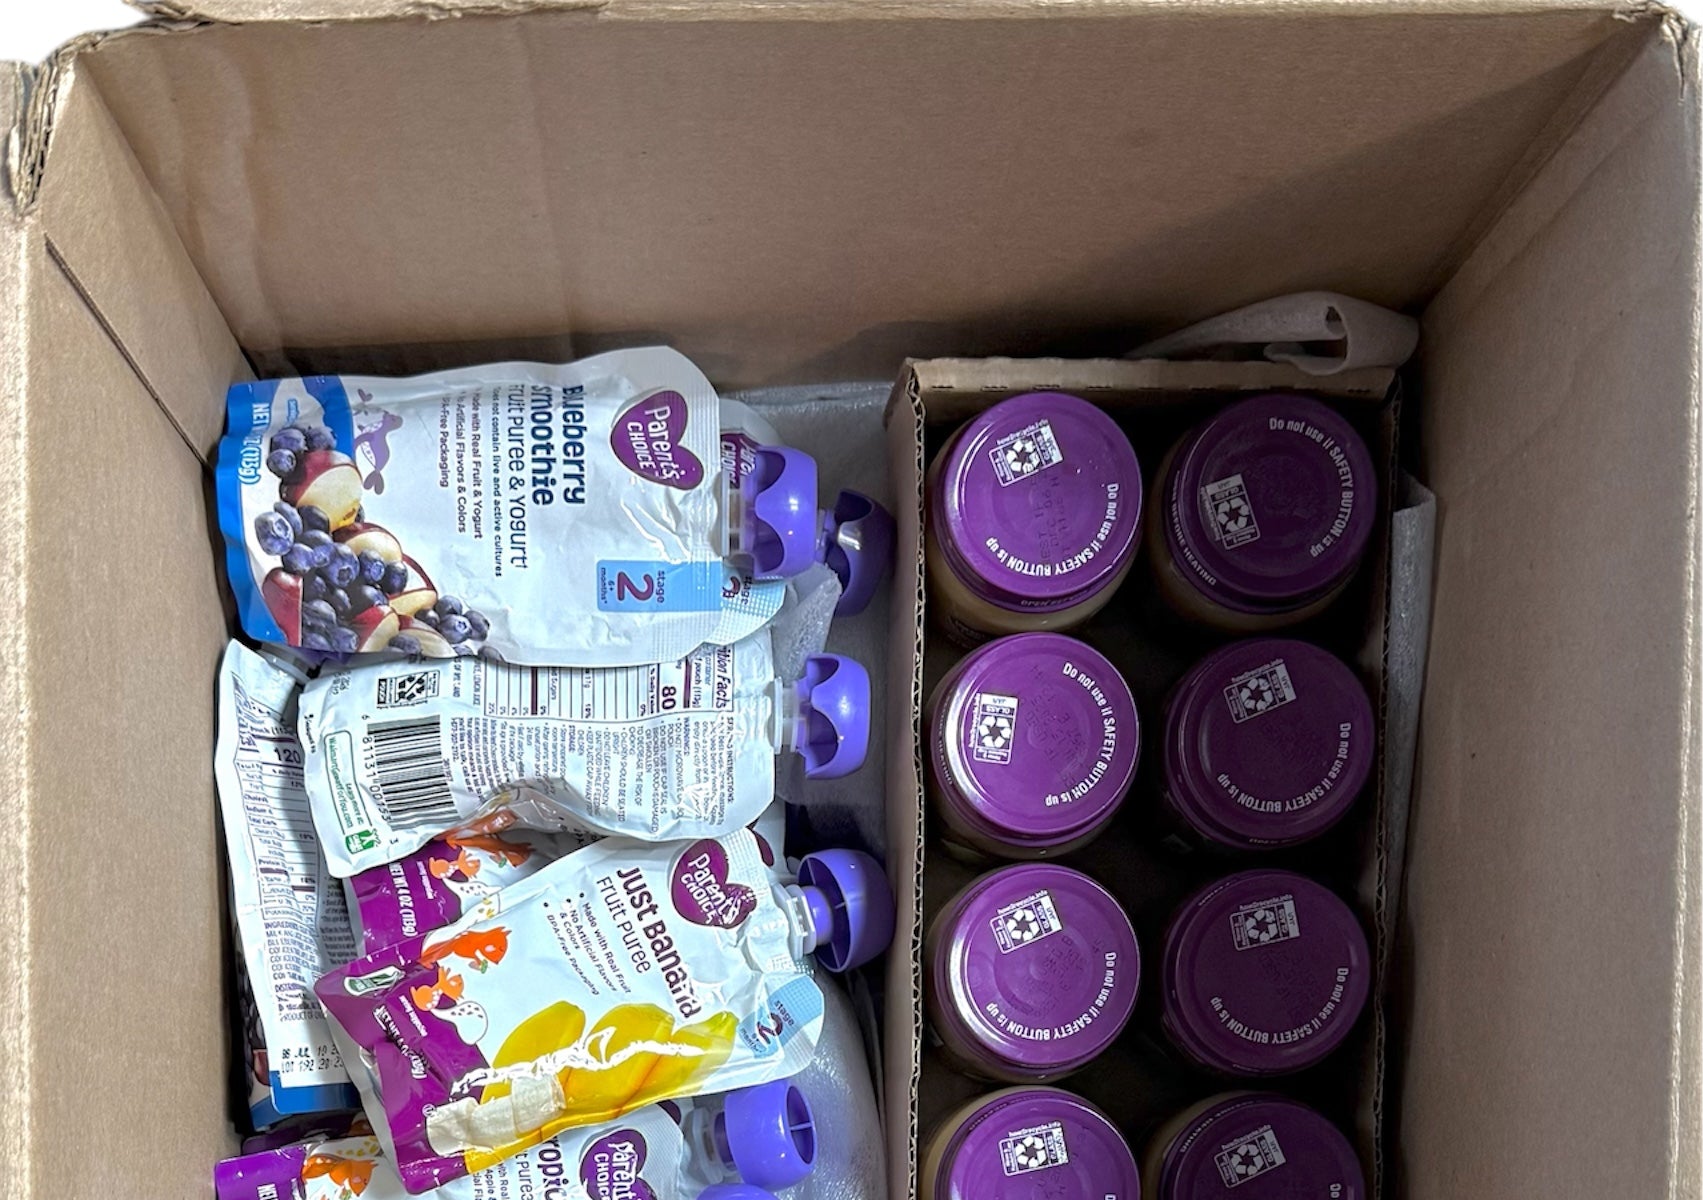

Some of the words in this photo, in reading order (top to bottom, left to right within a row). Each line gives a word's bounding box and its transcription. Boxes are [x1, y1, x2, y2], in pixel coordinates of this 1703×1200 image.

[1268, 417, 1285, 430] Do
[1286, 420, 1306, 433] not
[1304, 425, 1325, 443] use
[472, 433, 481, 458] Real
[508, 416, 525, 472] Puree
[531, 384, 558, 506] smoothie
[562, 384, 587, 505] Blueberry
[627, 421, 657, 470] CHOICE
[645, 405, 687, 480] Parent's
[1322, 437, 1335, 450] if
[438, 430, 449, 488] Packaging
[456, 441, 466, 485] Flavors
[1328, 446, 1354, 488] SAFETY
[472, 460, 482, 487] Fruit
[510, 475, 525, 491] &
[493, 476, 503, 497] and
[1107, 483, 1119, 500] Do
[457, 496, 467, 533] Colors
[471, 500, 484, 539] Yogurt
[494, 498, 503, 532] active
[1105, 501, 1117, 521] not
[1329, 490, 1354, 537] BUTTON
[1096, 521, 1112, 541] use
[1321, 534, 1334, 547] is
[494, 534, 504, 577] cultures
[985, 537, 1000, 553] up
[996, 548, 1009, 563] is
[1090, 539, 1103, 552] if
[1309, 543, 1325, 558] up
[1006, 555, 1052, 577] BUTTON
[1054, 547, 1095, 575] SAFETY
[617, 570, 654, 602] 2
[656, 570, 668, 604] stage
[1062, 662, 1078, 678] Do
[1076, 673, 1096, 691] not
[661, 685, 677, 712] 80
[1091, 687, 1107, 707] use
[1101, 706, 1113, 716] if
[1100, 717, 1116, 761] SAFETY
[1071, 760, 1108, 799] BUTTON
[1045, 794, 1060, 807] up
[1060, 791, 1073, 803] is
[617, 867, 658, 925] Just
[680, 873, 719, 925] CHOICE
[582, 903, 599, 928] Made
[595, 875, 626, 921] Fruit
[616, 923, 652, 974] Puree
[562, 920, 580, 951] Colors
[575, 923, 603, 963] Artificial
[590, 929, 608, 951] with
[601, 951, 620, 973] Real
[1104, 952, 1117, 968] Do
[612, 973, 632, 994] Fruit
[1103, 969, 1115, 988] not
[1094, 988, 1110, 1007] use
[773, 1000, 796, 1027] stage
[986, 1002, 1000, 1017] up
[997, 1013, 1009, 1027] is
[1088, 1005, 1100, 1018] if
[756, 1013, 784, 1045] 2
[1006, 1020, 1051, 1041] BUTTON
[1053, 1013, 1093, 1039] SAFETY
[256, 1183, 278, 1199] NET
[485, 1168, 495, 1194] Apple
[499, 1179, 509, 1200] Real
